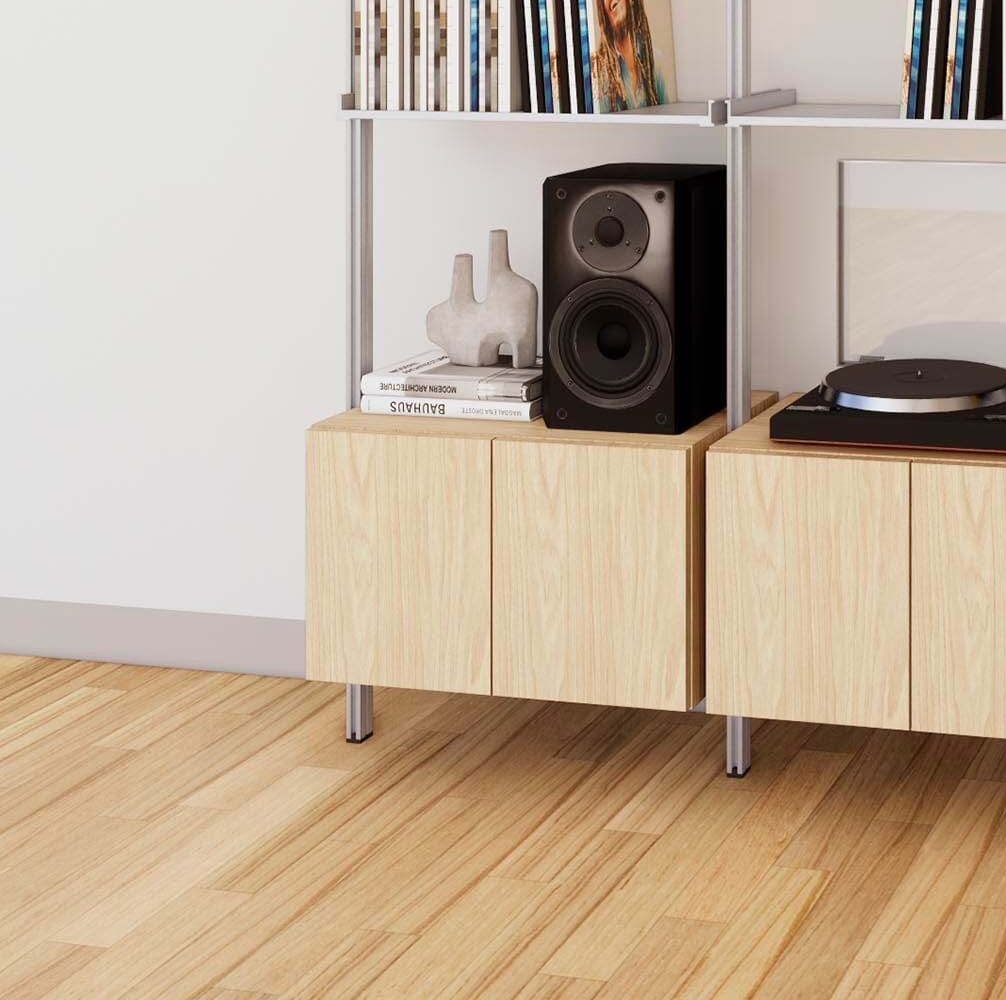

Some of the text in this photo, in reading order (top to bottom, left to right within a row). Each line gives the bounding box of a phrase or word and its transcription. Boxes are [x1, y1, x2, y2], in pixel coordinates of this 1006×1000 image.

[379, 383, 457, 393] MODERN ARCHITECTURE
[390, 401, 446, 415] BAUHAUS
